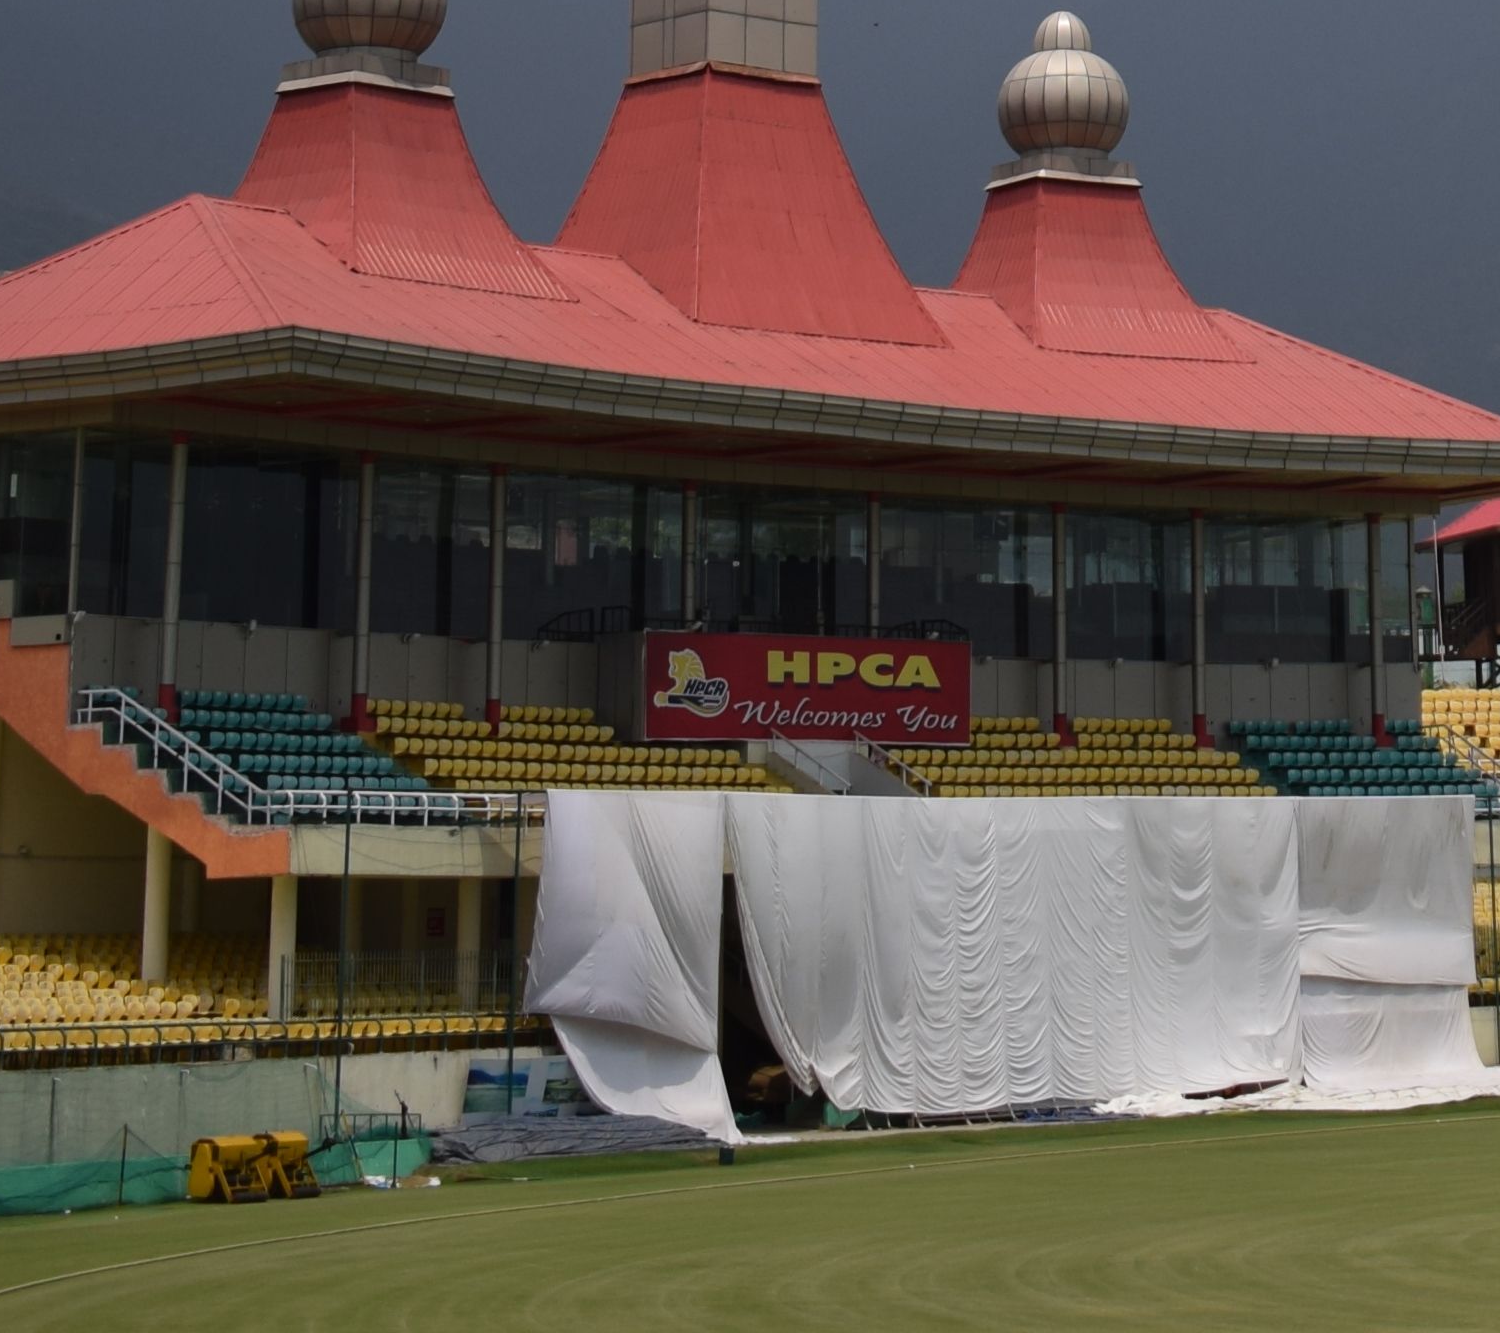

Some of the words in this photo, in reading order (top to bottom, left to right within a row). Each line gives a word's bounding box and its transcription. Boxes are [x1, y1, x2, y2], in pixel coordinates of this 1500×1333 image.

[683, 678, 726, 696] HPCA
[766, 650, 941, 689] HPCA
[733, 696, 886, 728] Welcomes
[896, 704, 959, 733] You
